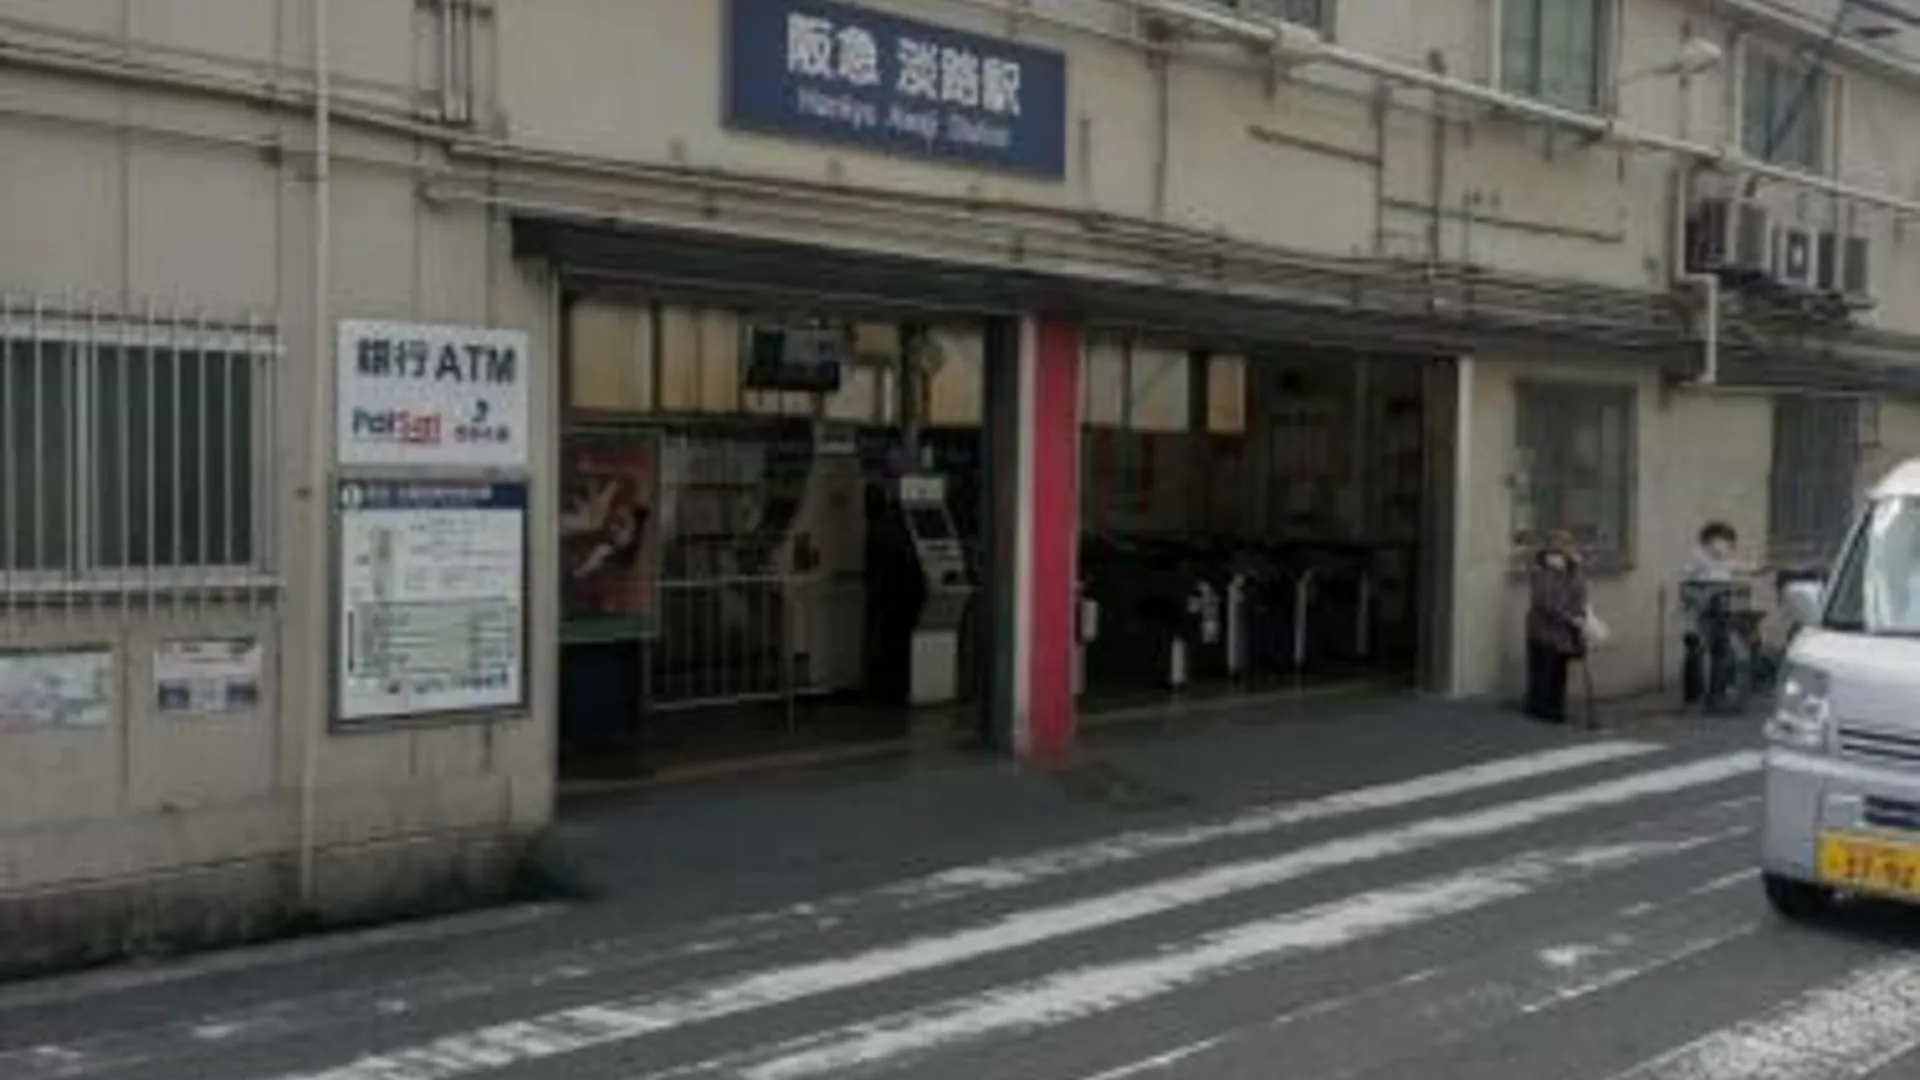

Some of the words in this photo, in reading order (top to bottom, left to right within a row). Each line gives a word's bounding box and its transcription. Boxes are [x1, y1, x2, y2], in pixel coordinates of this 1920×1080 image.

[787, 12, 880, 86] 阪急
[896, 37, 1021, 117] 淡路駅
